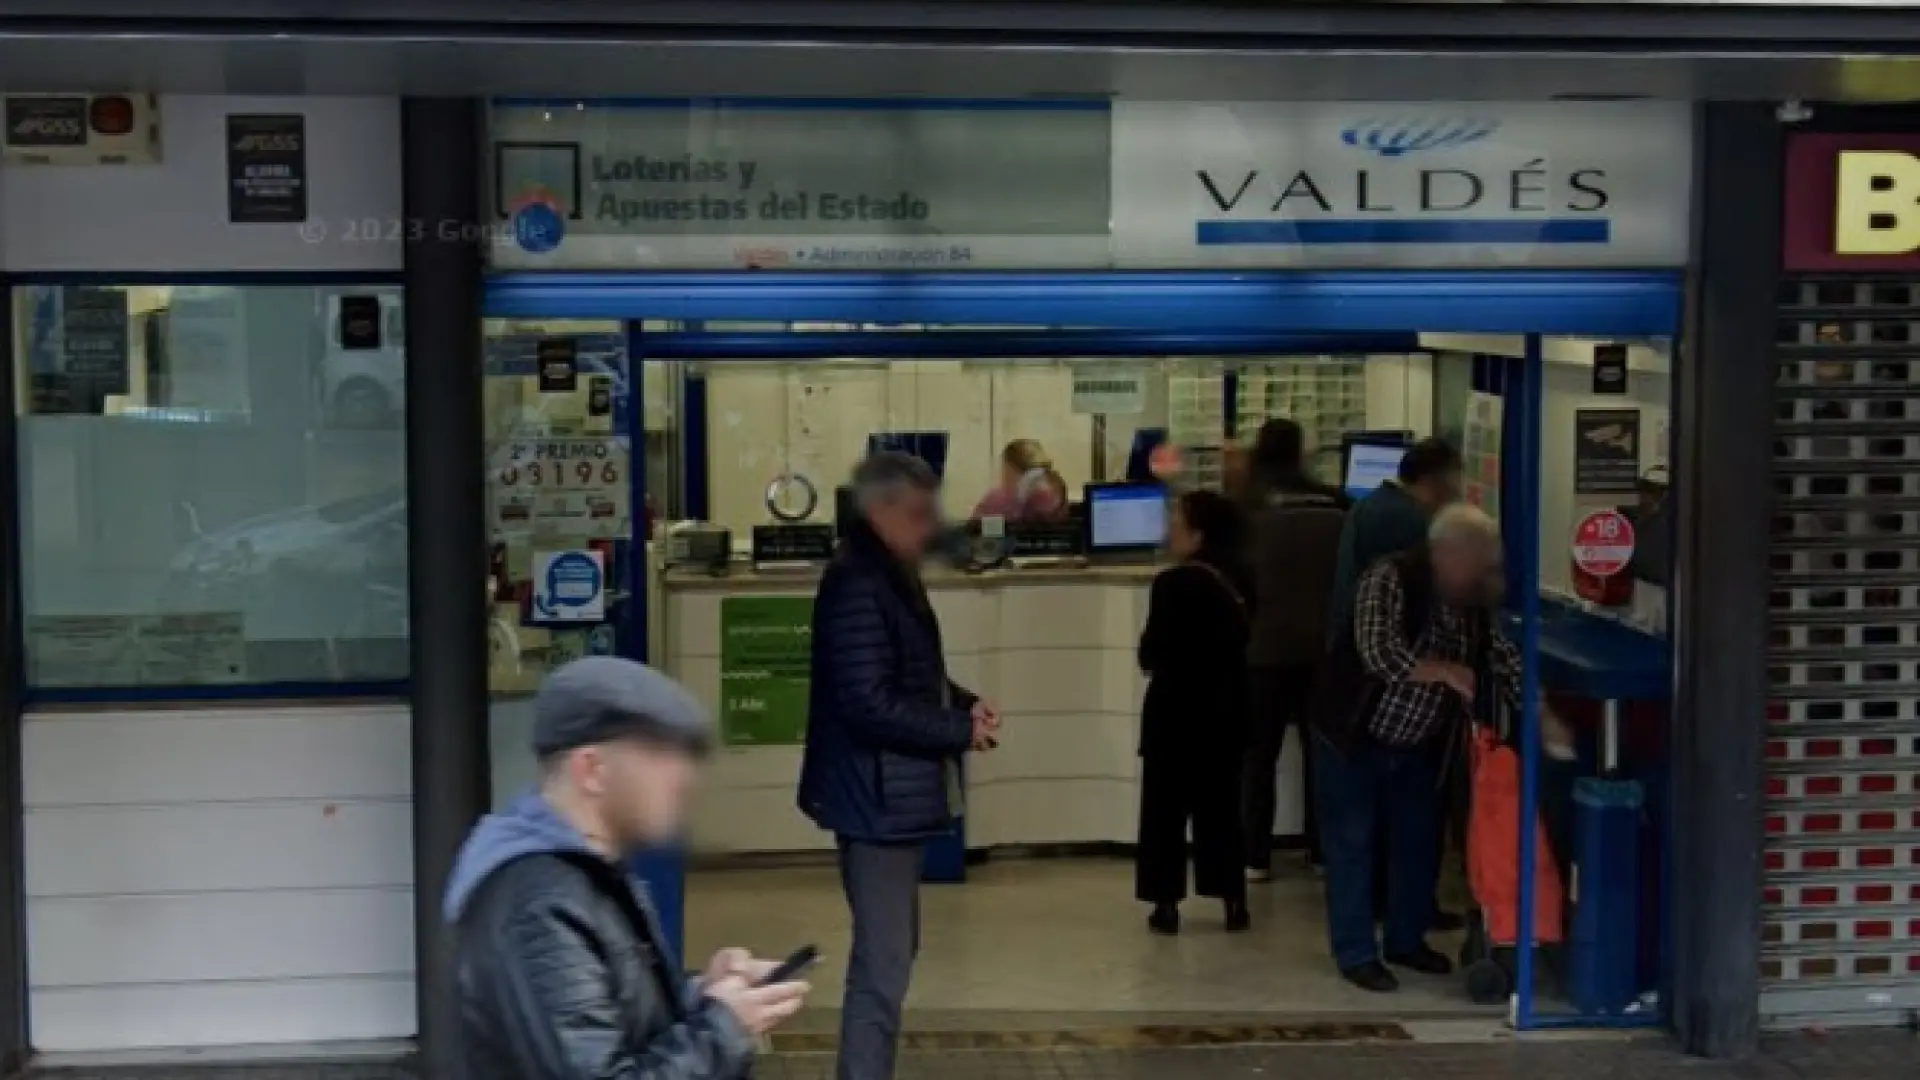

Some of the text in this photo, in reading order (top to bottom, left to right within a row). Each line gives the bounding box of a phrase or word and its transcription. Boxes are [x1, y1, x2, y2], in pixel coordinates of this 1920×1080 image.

[737, 161, 758, 190] y
[1196, 158, 1610, 212] VALDÉS
[595, 190, 930, 225] Apuestas del Estado
[499, 461, 620, 486] 03196
